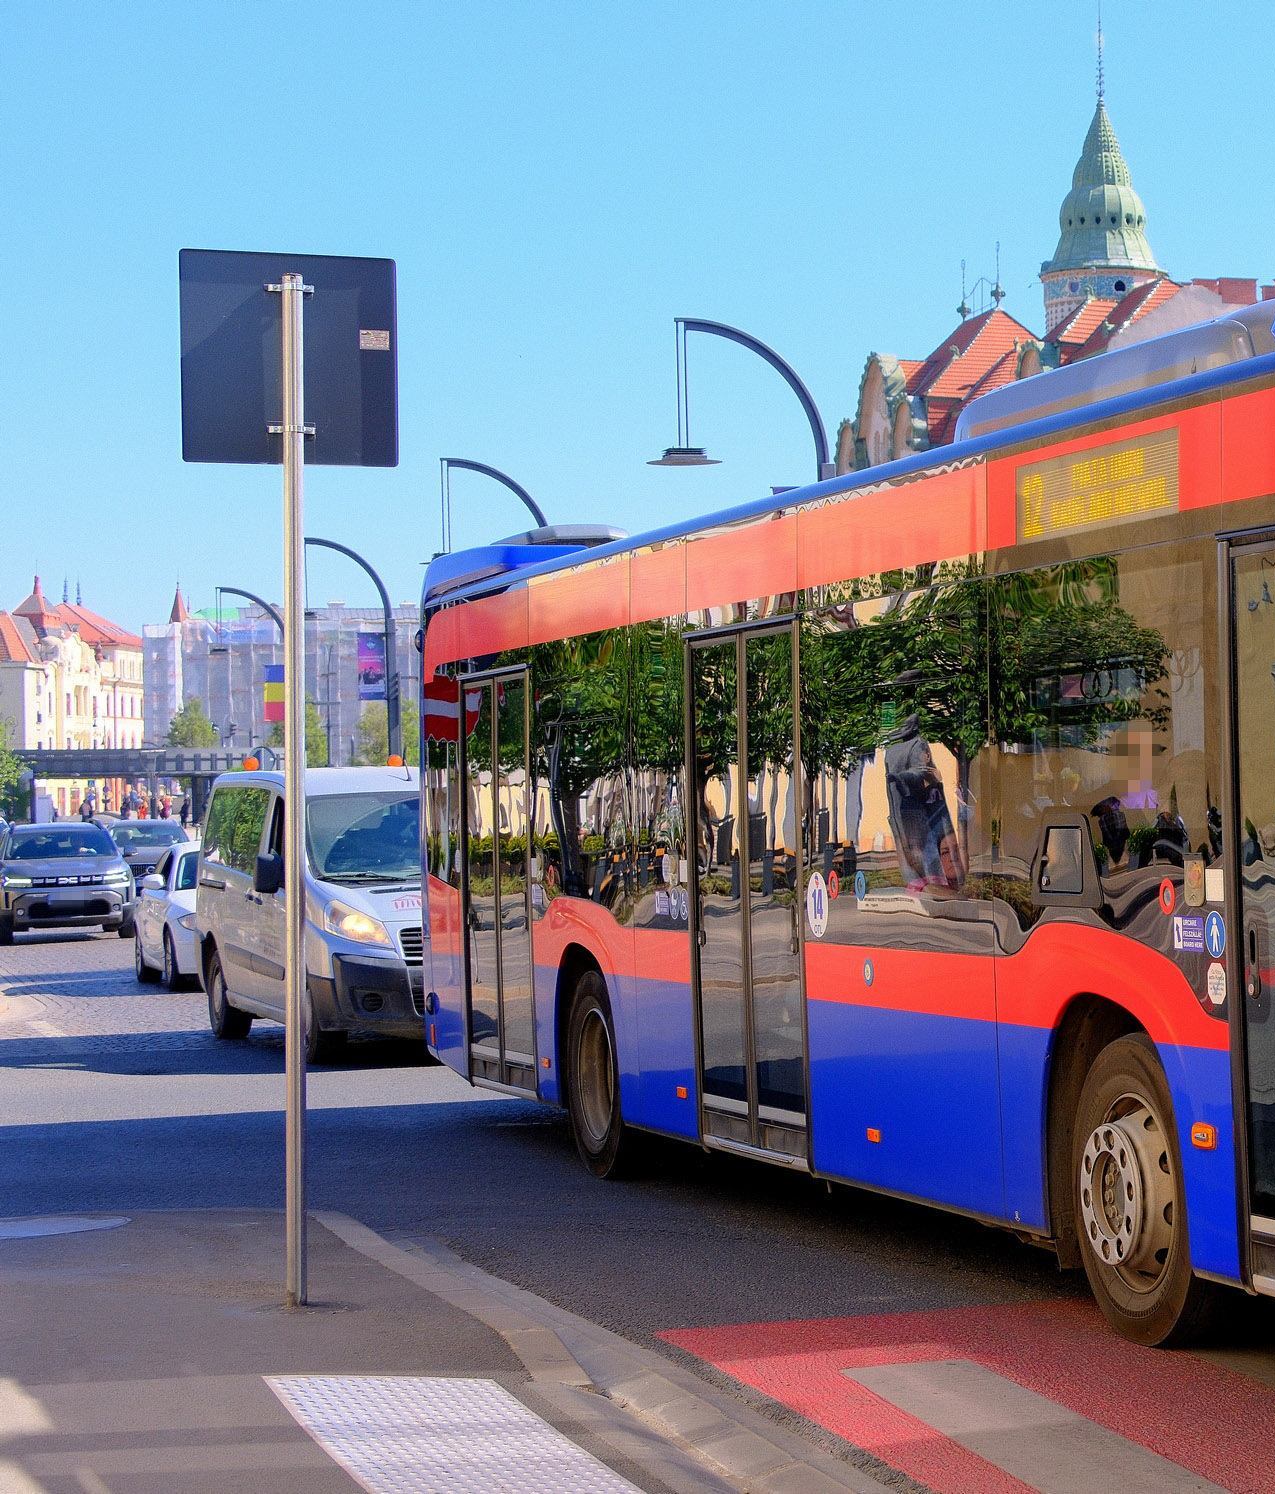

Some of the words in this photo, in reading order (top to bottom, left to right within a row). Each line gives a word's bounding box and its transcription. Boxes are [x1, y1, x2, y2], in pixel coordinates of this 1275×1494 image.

[1023, 473, 1044, 538] 12
[811, 889, 824, 919] 14
[814, 924, 823, 935] OTL
